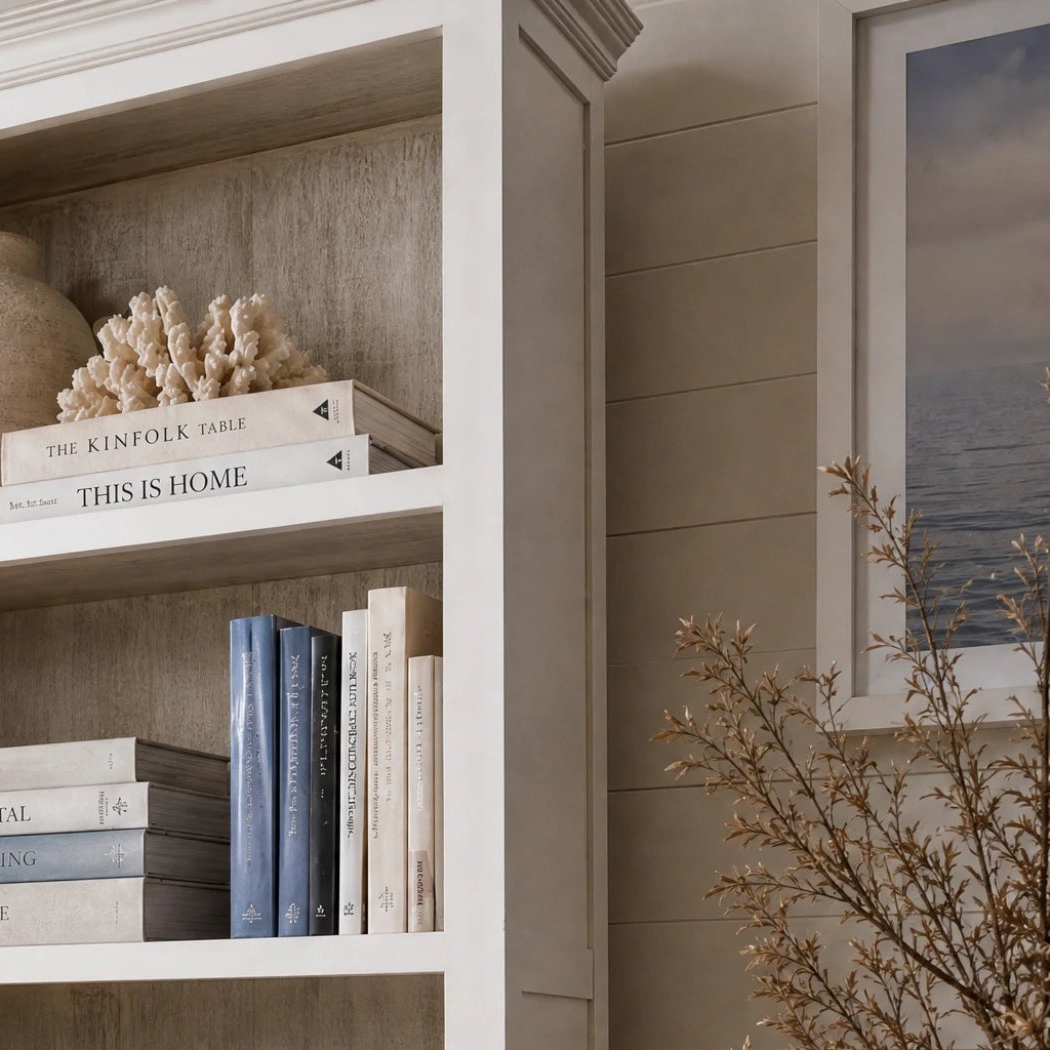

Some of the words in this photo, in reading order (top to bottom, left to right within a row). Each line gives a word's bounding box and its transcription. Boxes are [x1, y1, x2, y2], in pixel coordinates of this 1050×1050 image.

[46, 440, 78, 459] THE
[87, 423, 189, 454] KINFOLK
[197, 416, 247, 436] TABLE
[76, 482, 134, 508] THIS
[141, 478, 162, 500] IS
[169, 465, 248, 497] HOME
